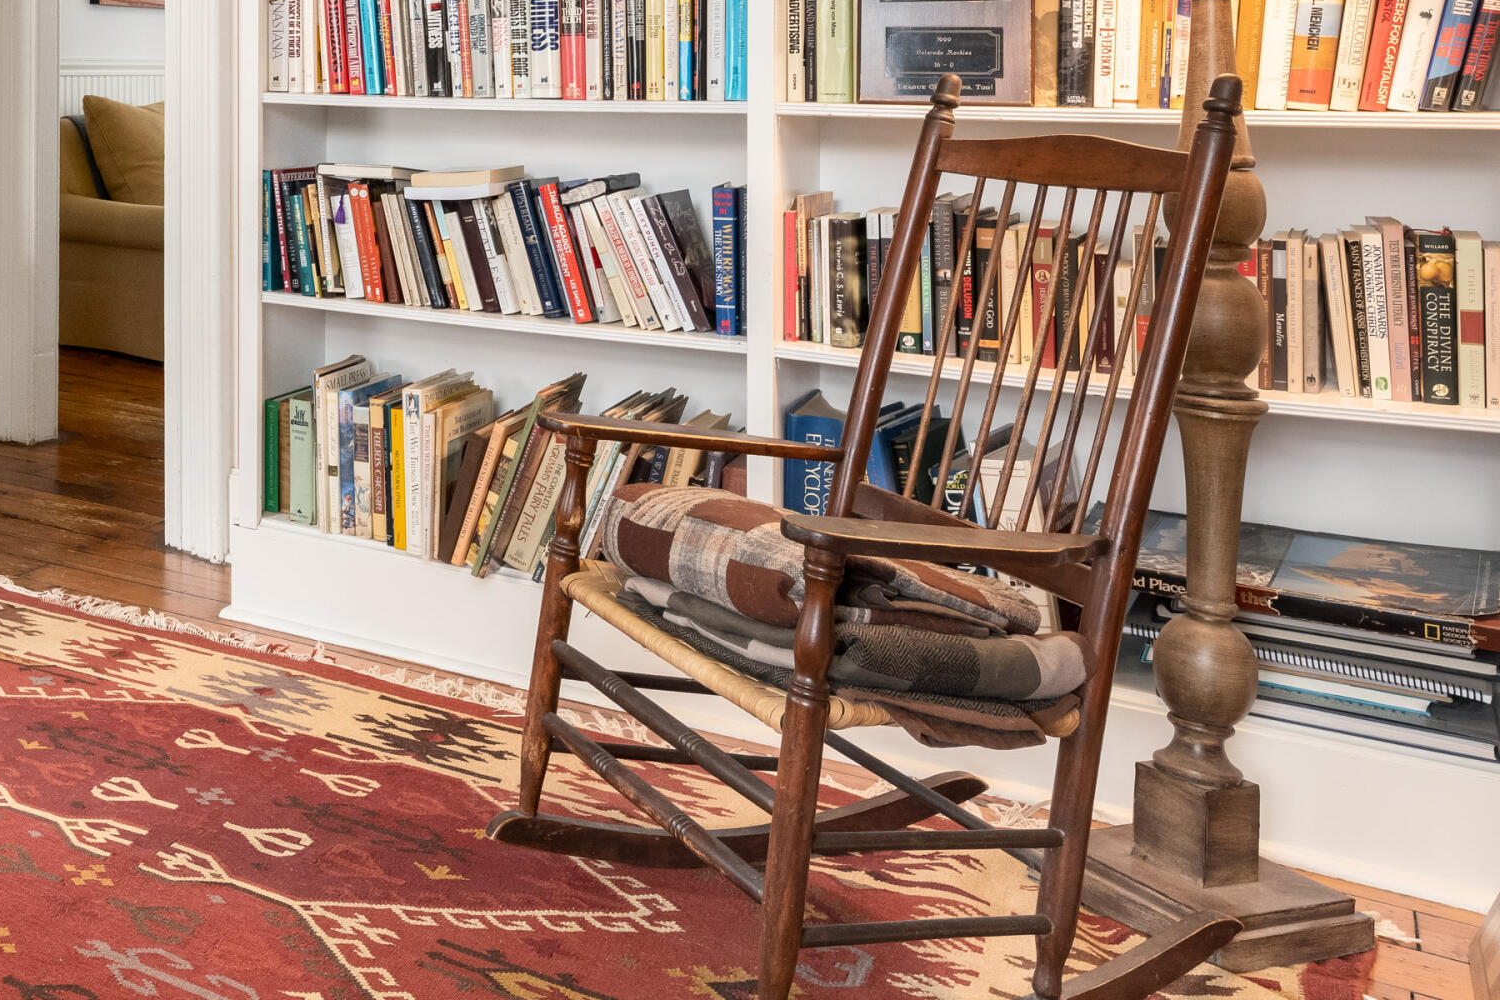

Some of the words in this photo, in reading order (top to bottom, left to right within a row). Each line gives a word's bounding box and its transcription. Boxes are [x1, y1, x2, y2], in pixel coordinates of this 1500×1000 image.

[1306, 7, 1323, 51] MENCKEN
[1387, 24, 1401, 45] FOR
[1375, 46, 1397, 105] CAPITALISM
[549, 190, 557, 205] THE
[553, 205, 563, 224] PLOT
[558, 224, 572, 254] AGAINST
[550, 224, 560, 240] THE
[714, 230, 722, 245] THE
[722, 223, 733, 255] WITH
[554, 239, 571, 278] PRESIDENT
[715, 246, 723, 270] INSIDE
[1363, 244, 1371, 260] ON
[1372, 244, 1384, 293] JONATHAN
[715, 270, 724, 297] STORY
[723, 257, 734, 303] REAGAN
[1363, 260, 1376, 304] KNOWING
[1368, 305, 1378, 337] CHRIST
[1376, 293, 1388, 339] EDWARDS
[1439, 292, 1450, 320] THE
[1425, 292, 1439, 372] CONSPIRACY
[1439, 324, 1452, 372] DIVINE
[373, 430, 382, 468] JULIUS
[373, 470, 382, 511] CAESAR
